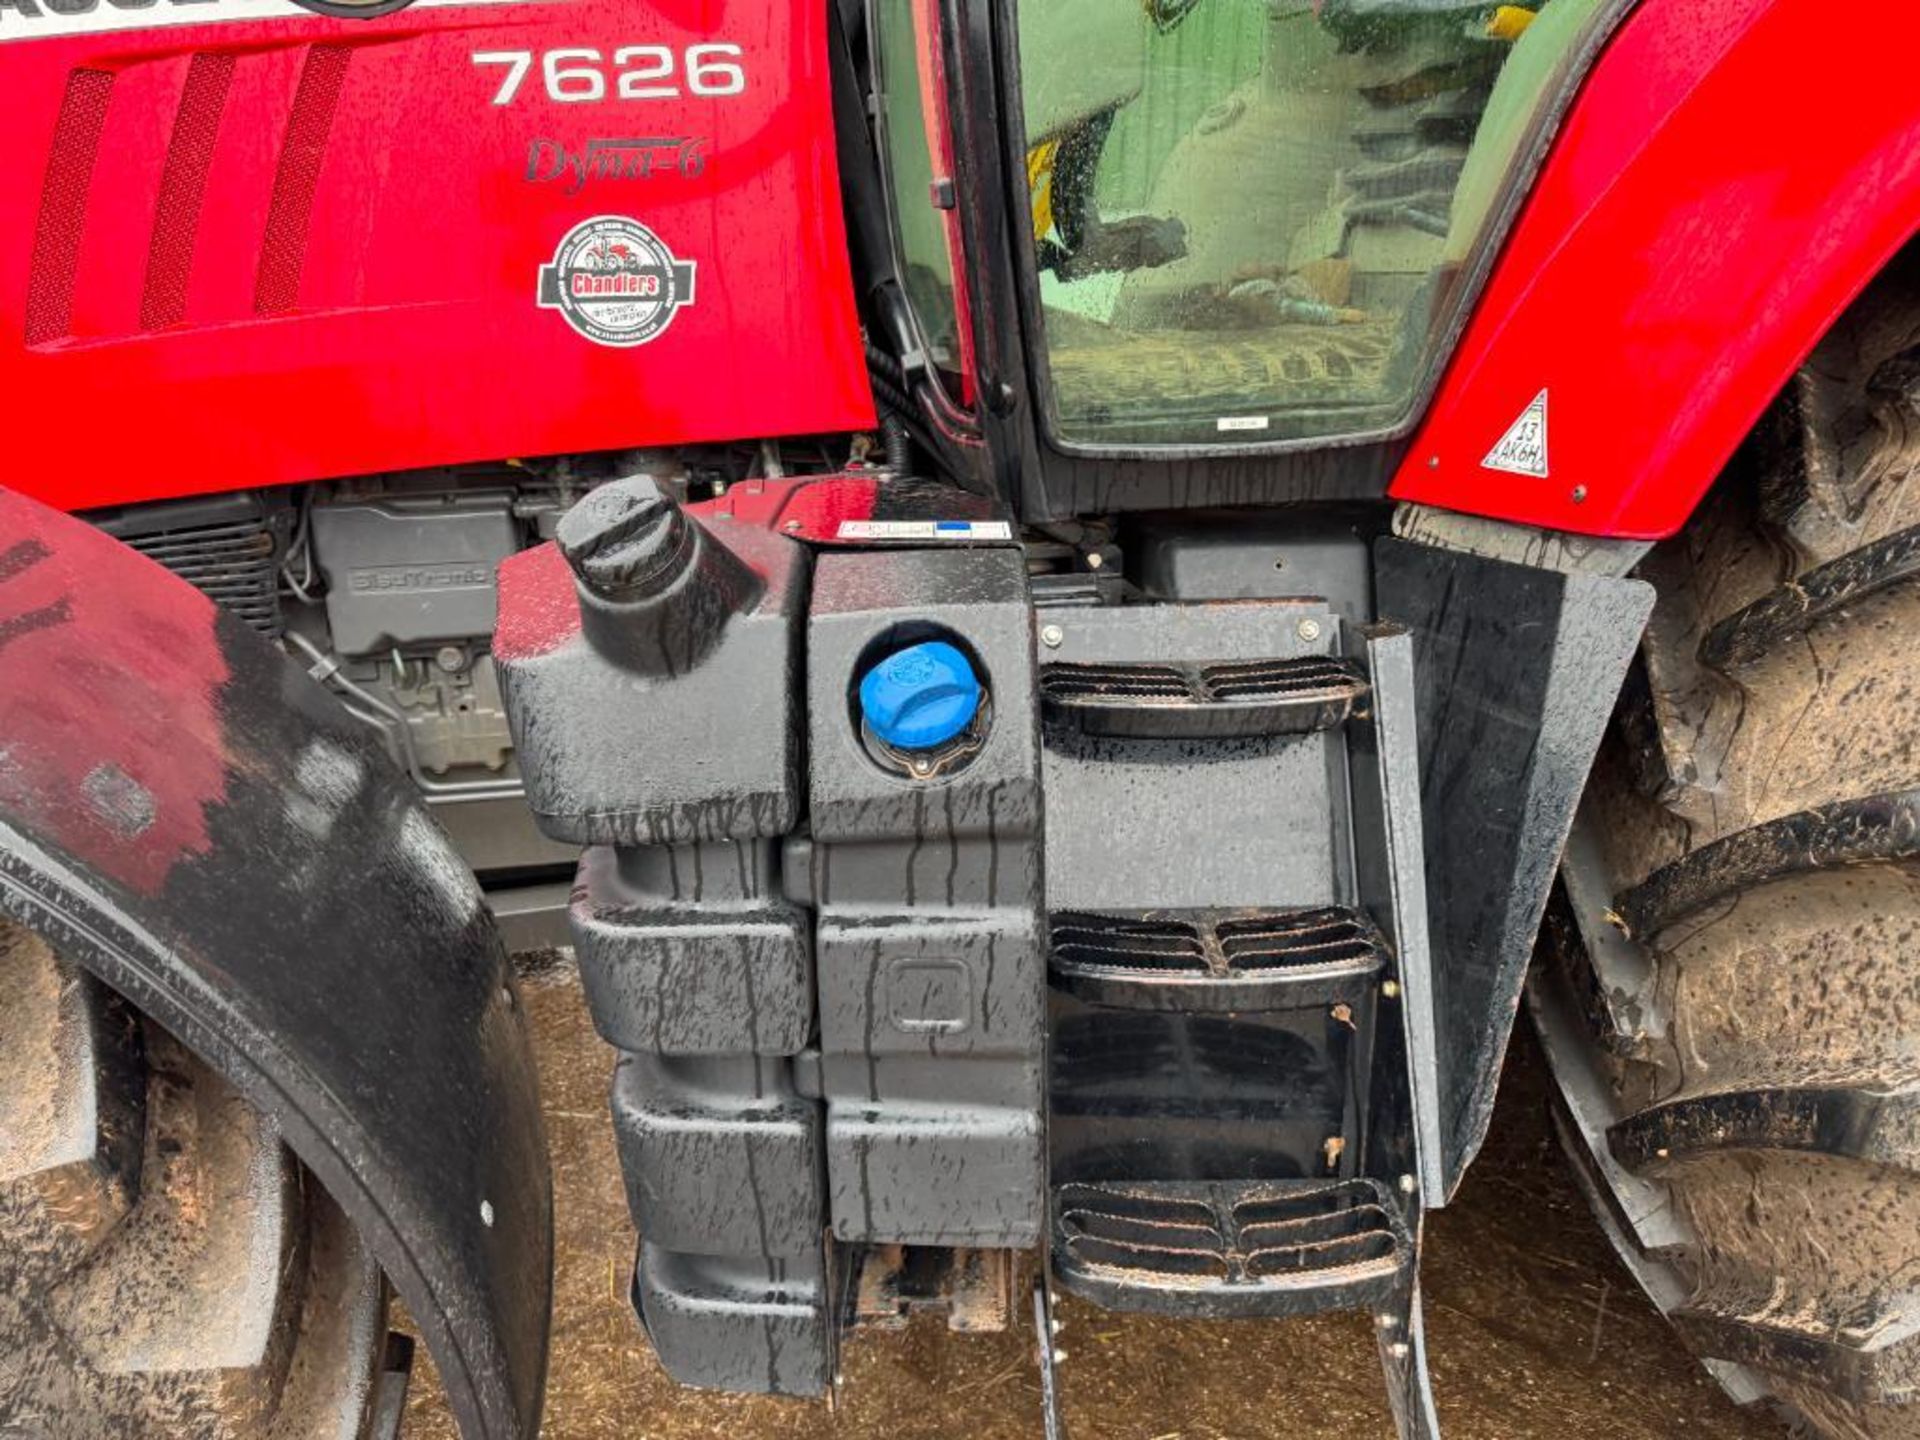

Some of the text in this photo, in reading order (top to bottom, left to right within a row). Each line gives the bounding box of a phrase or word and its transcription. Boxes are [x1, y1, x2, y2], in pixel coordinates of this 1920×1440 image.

[472, 43, 746, 106] 7626
[525, 136, 709, 195] Dyna-6
[571, 272, 659, 296] Chandlers
